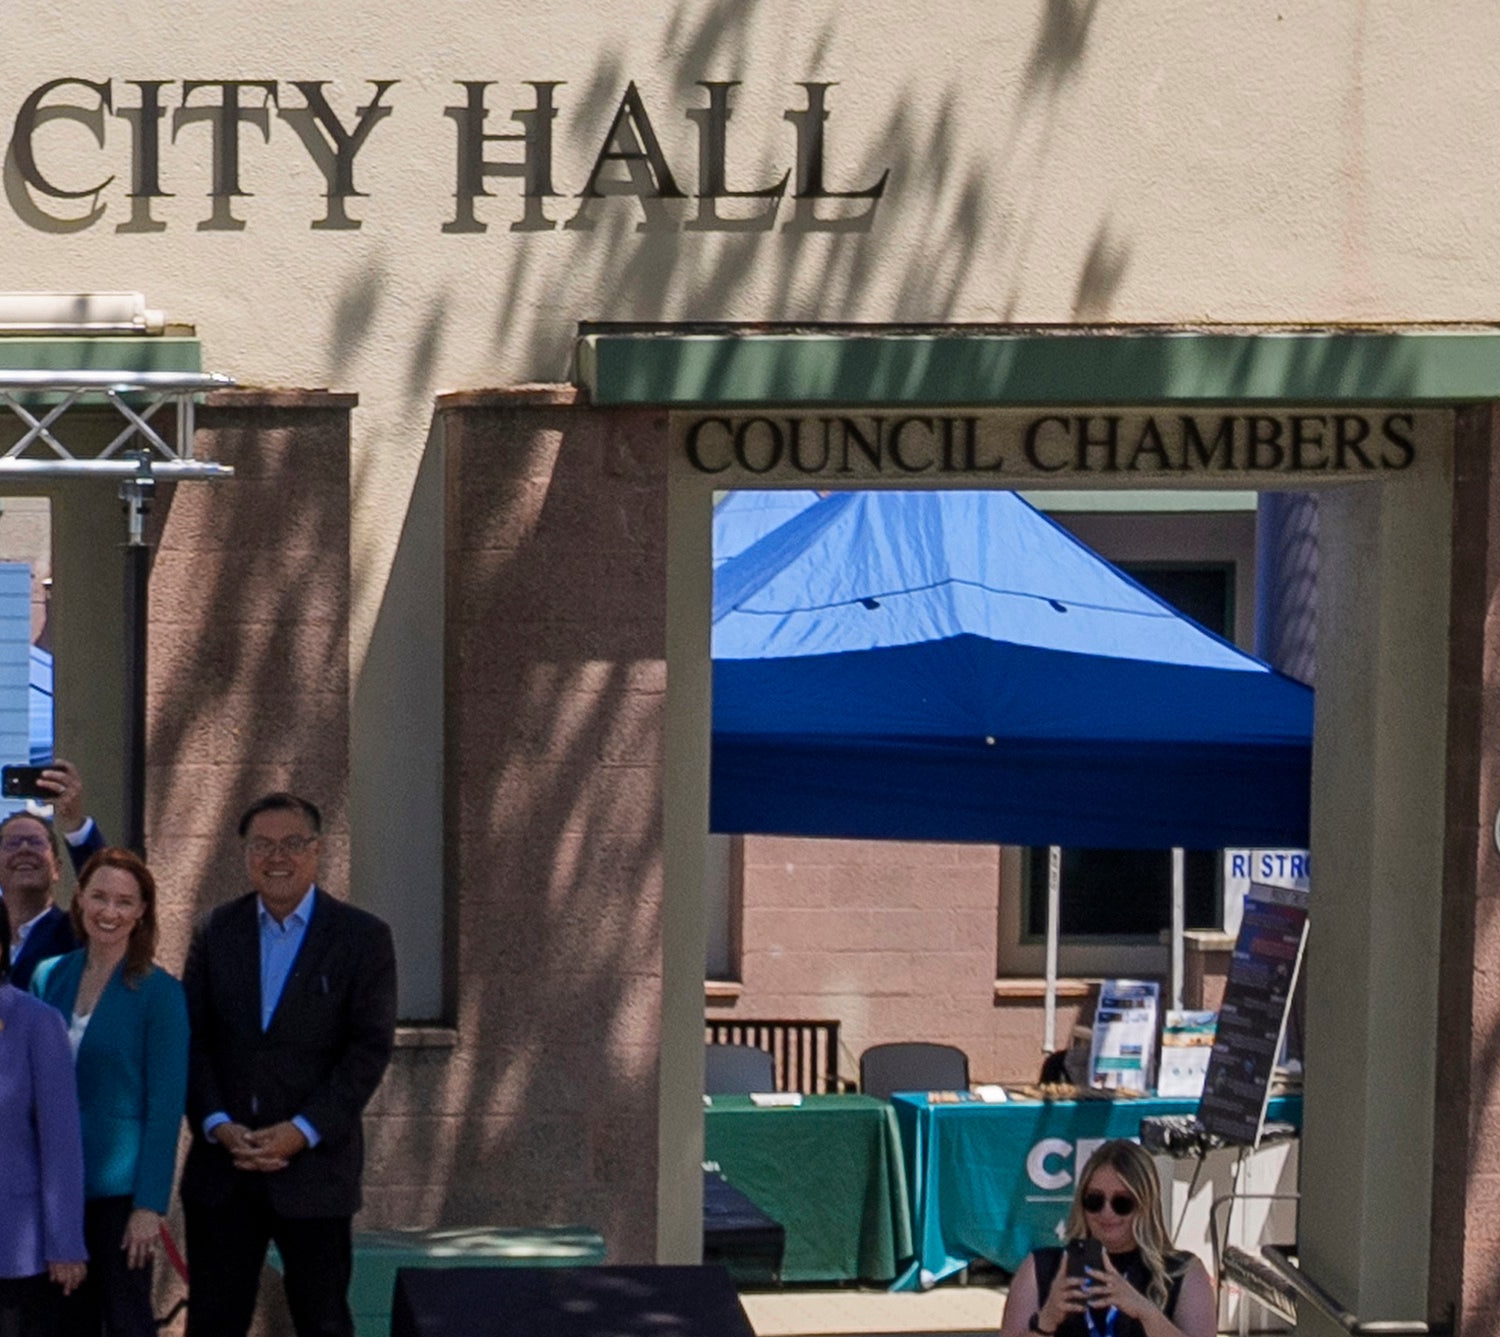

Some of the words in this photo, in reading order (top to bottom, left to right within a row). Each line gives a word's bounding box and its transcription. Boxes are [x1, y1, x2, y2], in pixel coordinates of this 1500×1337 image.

[13, 77, 403, 199] CITY
[451, 79, 891, 201] HALL
[684, 415, 1003, 476] COUNCIL
[1022, 412, 1418, 475] CHAMBERS
